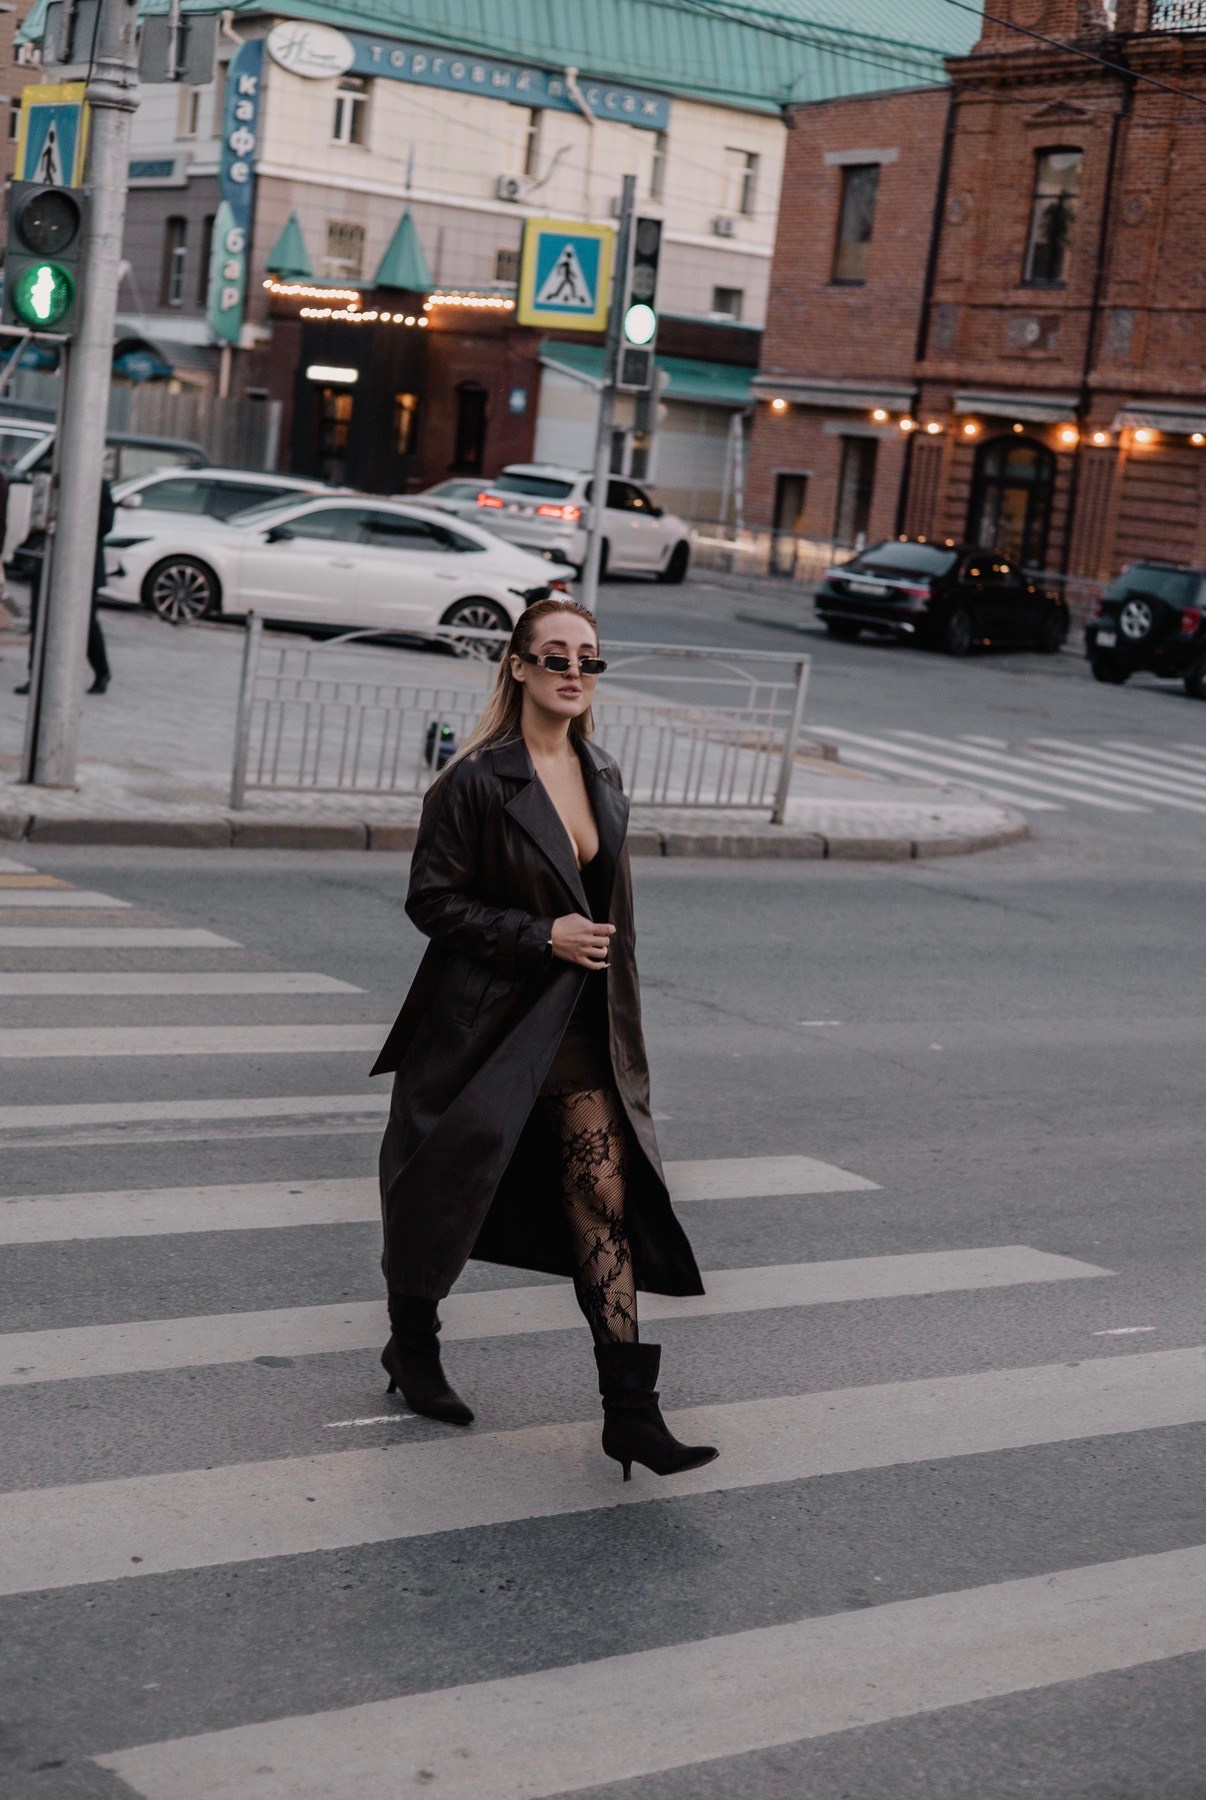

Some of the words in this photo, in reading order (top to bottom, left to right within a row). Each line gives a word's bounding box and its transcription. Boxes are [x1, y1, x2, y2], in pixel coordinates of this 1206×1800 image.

[369, 46, 531, 90] торговый
[548, 81, 658, 115] пссаж
[229, 74, 257, 183] кафе
[221, 227, 245, 311] бар
